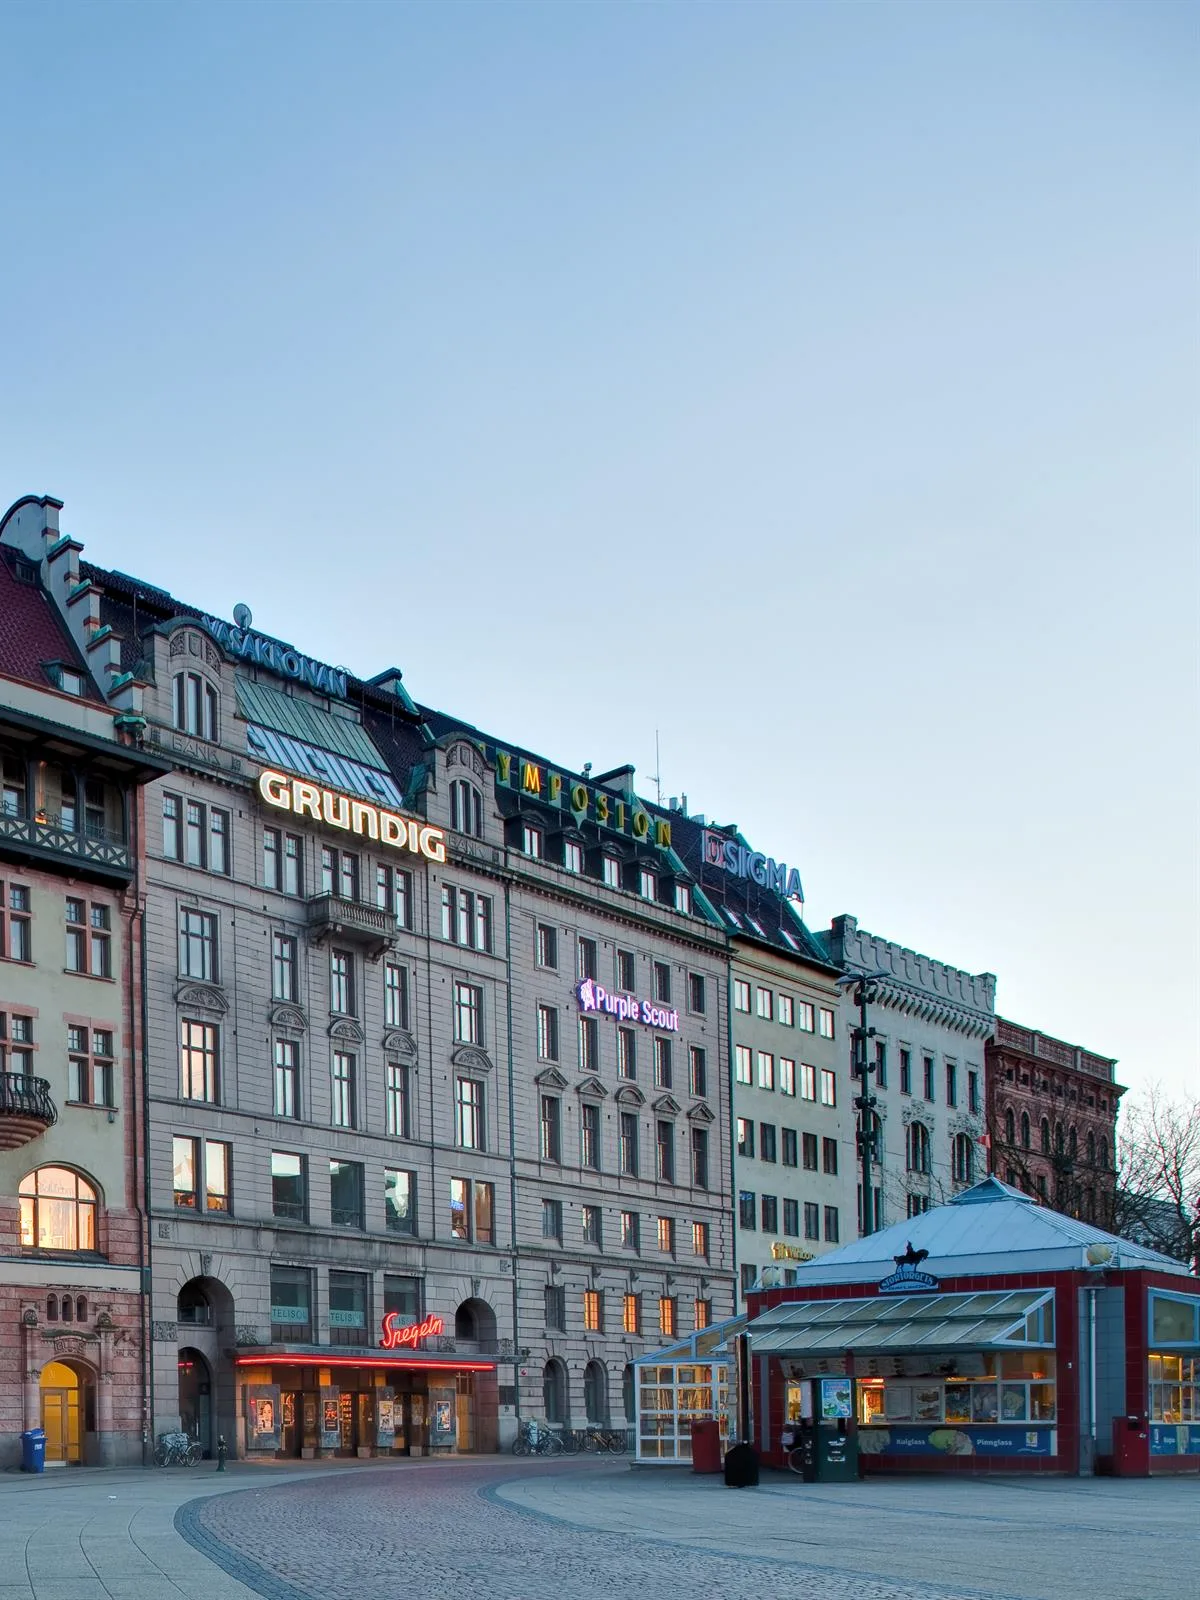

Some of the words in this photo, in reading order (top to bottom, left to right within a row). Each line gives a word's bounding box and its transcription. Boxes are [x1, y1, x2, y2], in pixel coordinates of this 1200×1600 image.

[202, 615, 347, 698] VASAKRONAN
[259, 769, 446, 863] GRUNDIG
[478, 743, 673, 848] YMPOSION
[723, 840, 804, 903] SIGMA
[595, 986, 639, 1020] Purple
[642, 1001, 679, 1031] Scout
[381, 1312, 443, 1348] Spegeln
